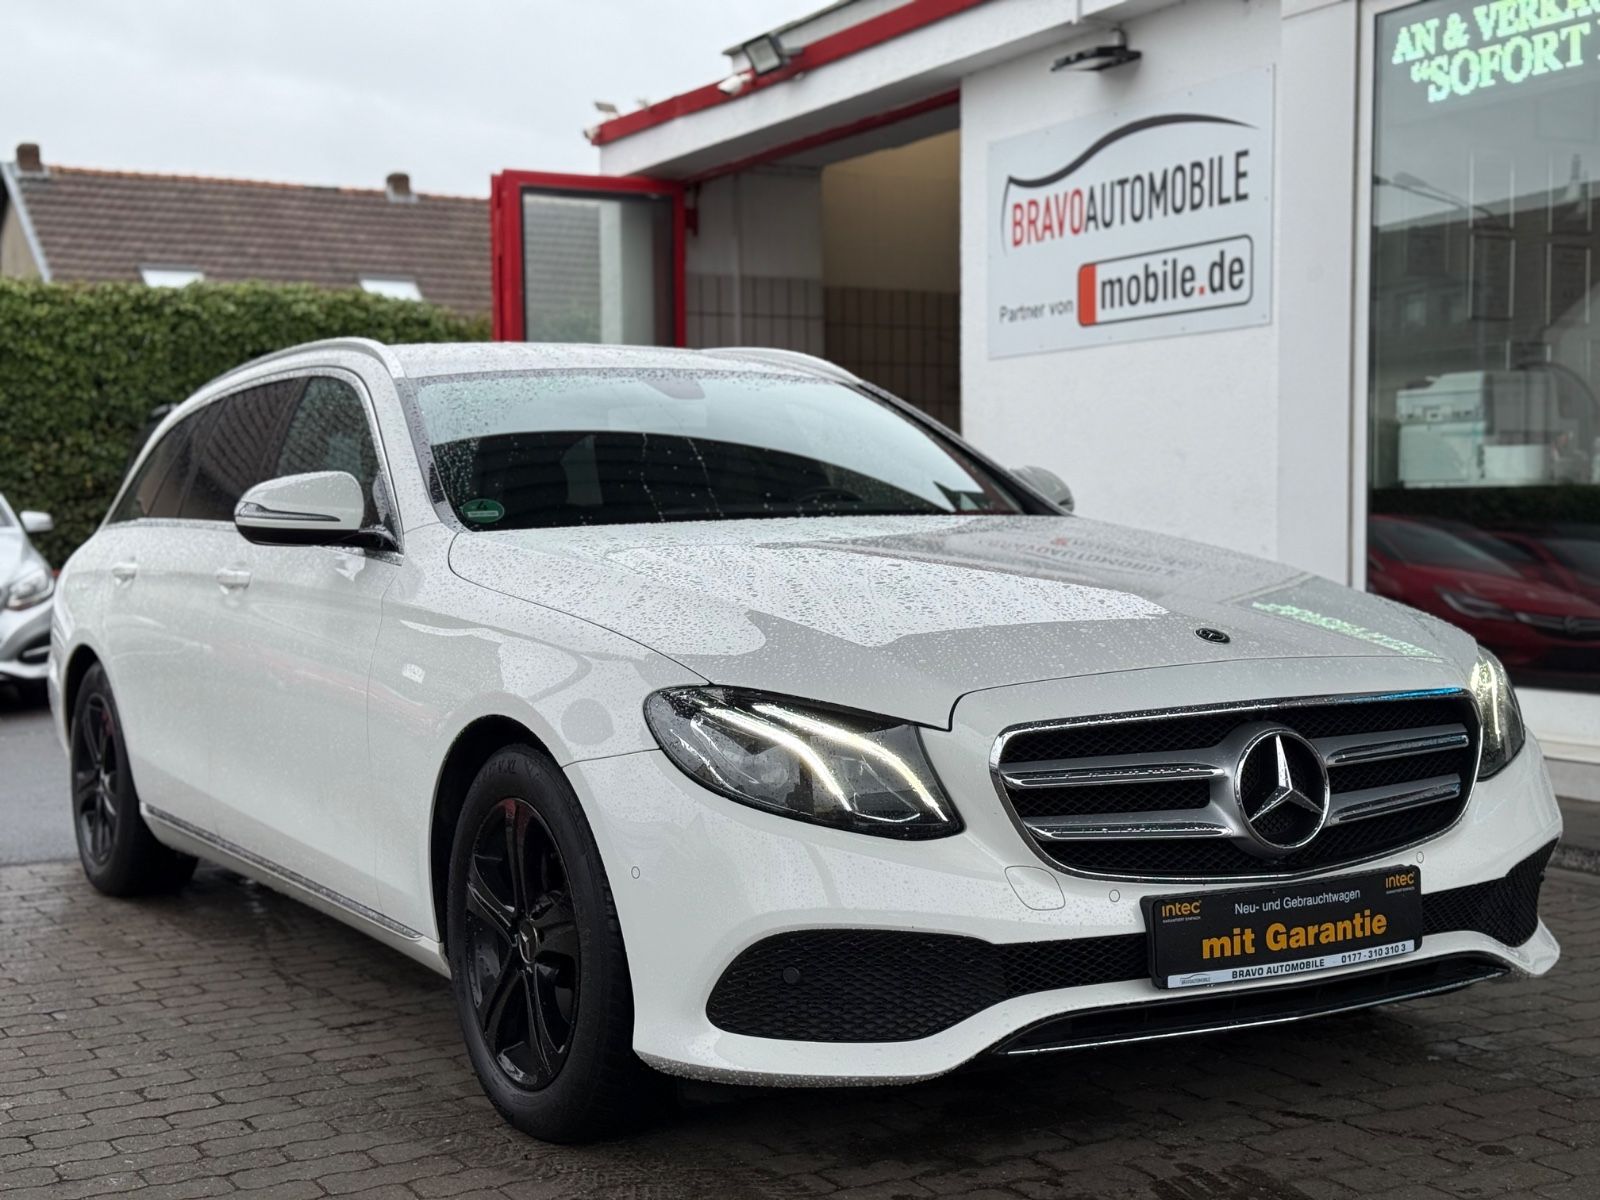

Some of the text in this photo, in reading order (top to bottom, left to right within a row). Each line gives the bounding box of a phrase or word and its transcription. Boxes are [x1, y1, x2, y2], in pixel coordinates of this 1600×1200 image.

[1392, 18, 1440, 65] AN
[1443, 12, 1470, 51] &
[999, 249, 1245, 323] Partner von mobile.de
[1234, 889, 1361, 915] Neu- und Gebrauchtwagen
[1202, 909, 1388, 959] mit Garantie
[1232, 967, 1264, 979] BRAVO
[1266, 958, 1325, 976] AUTOMOBILE
